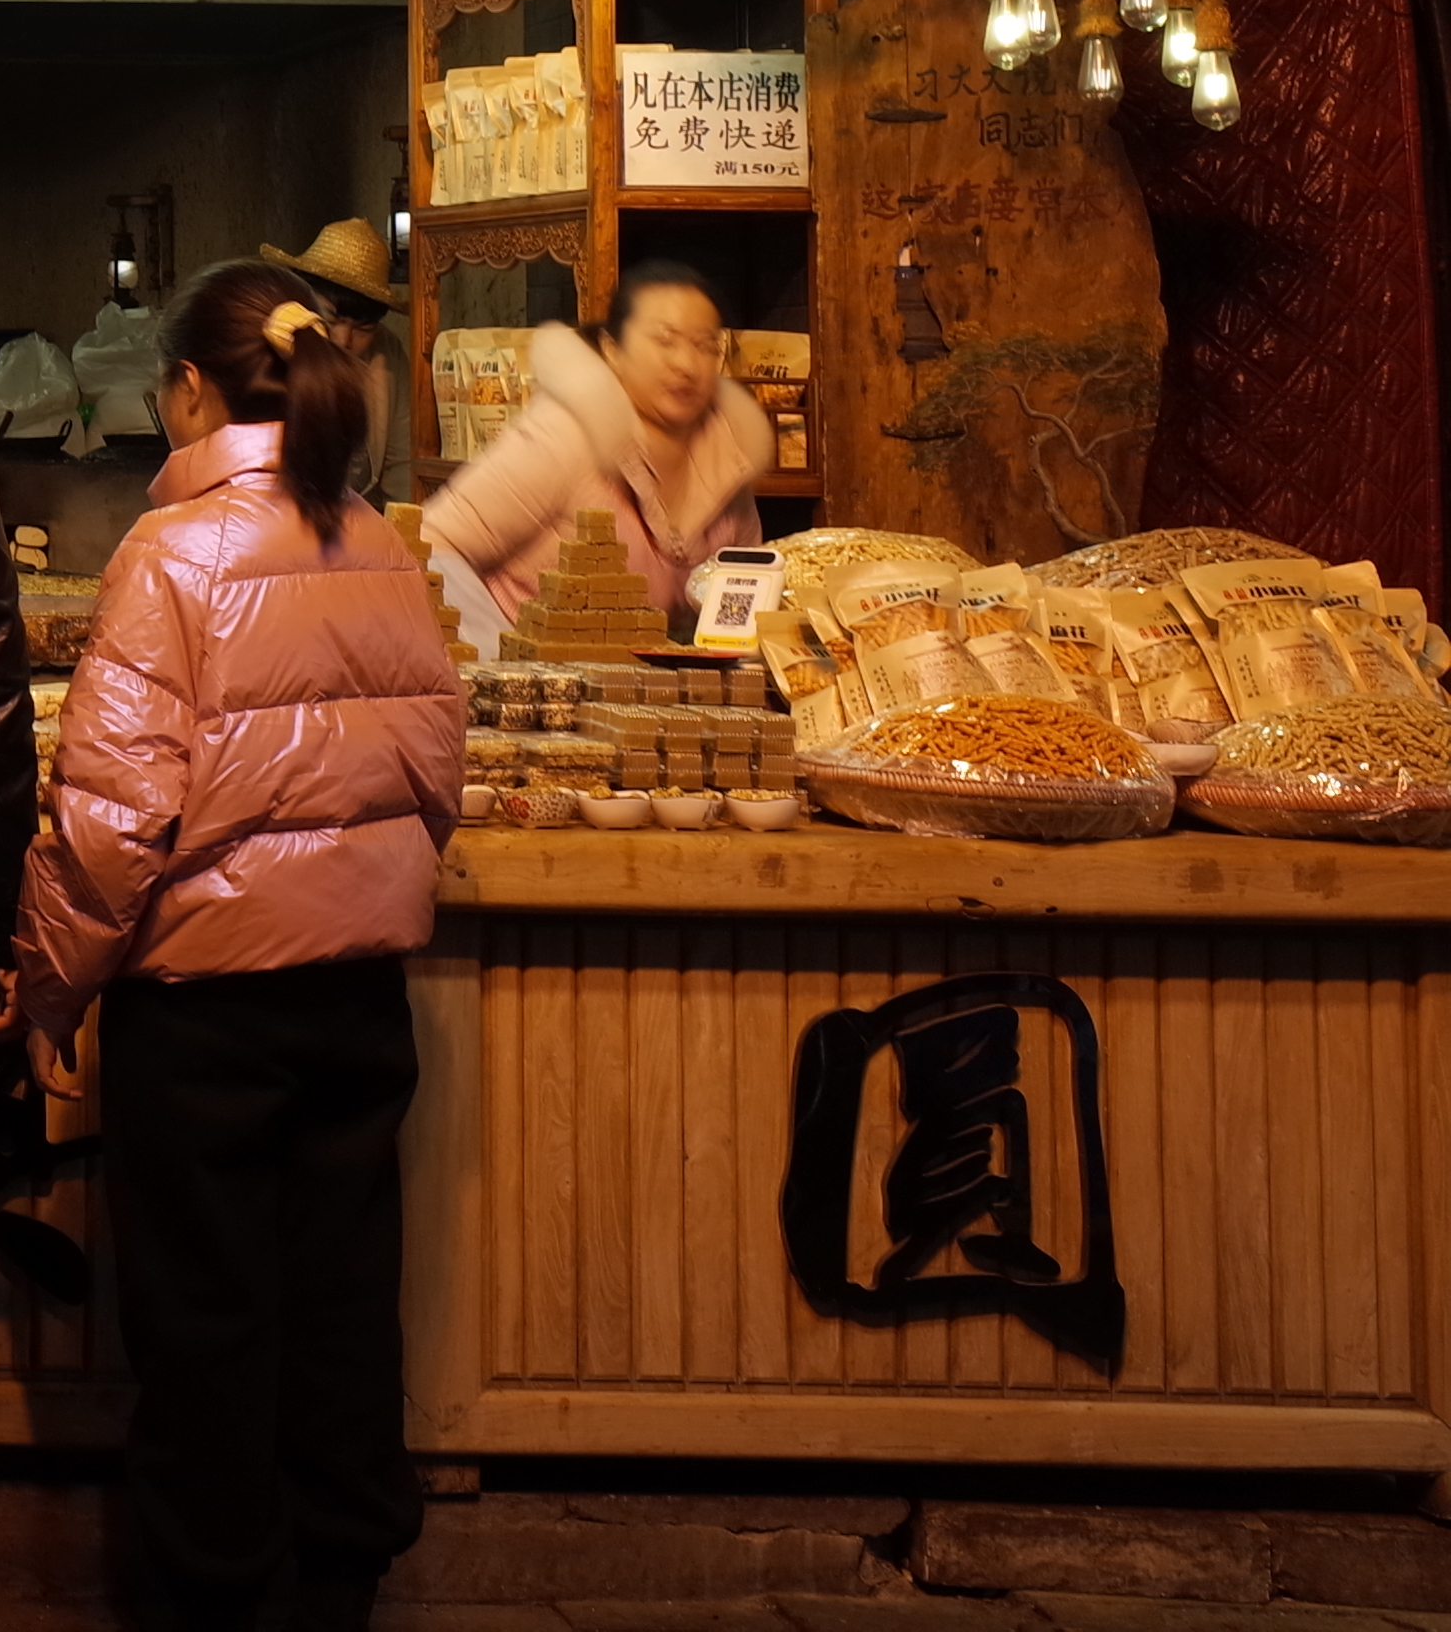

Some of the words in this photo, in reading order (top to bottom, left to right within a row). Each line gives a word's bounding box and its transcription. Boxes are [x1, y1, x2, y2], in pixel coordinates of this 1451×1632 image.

[628, 70, 801, 114] 凡在本店消费
[629, 116, 801, 153] 免费快递
[714, 161, 801, 176] 满150元
